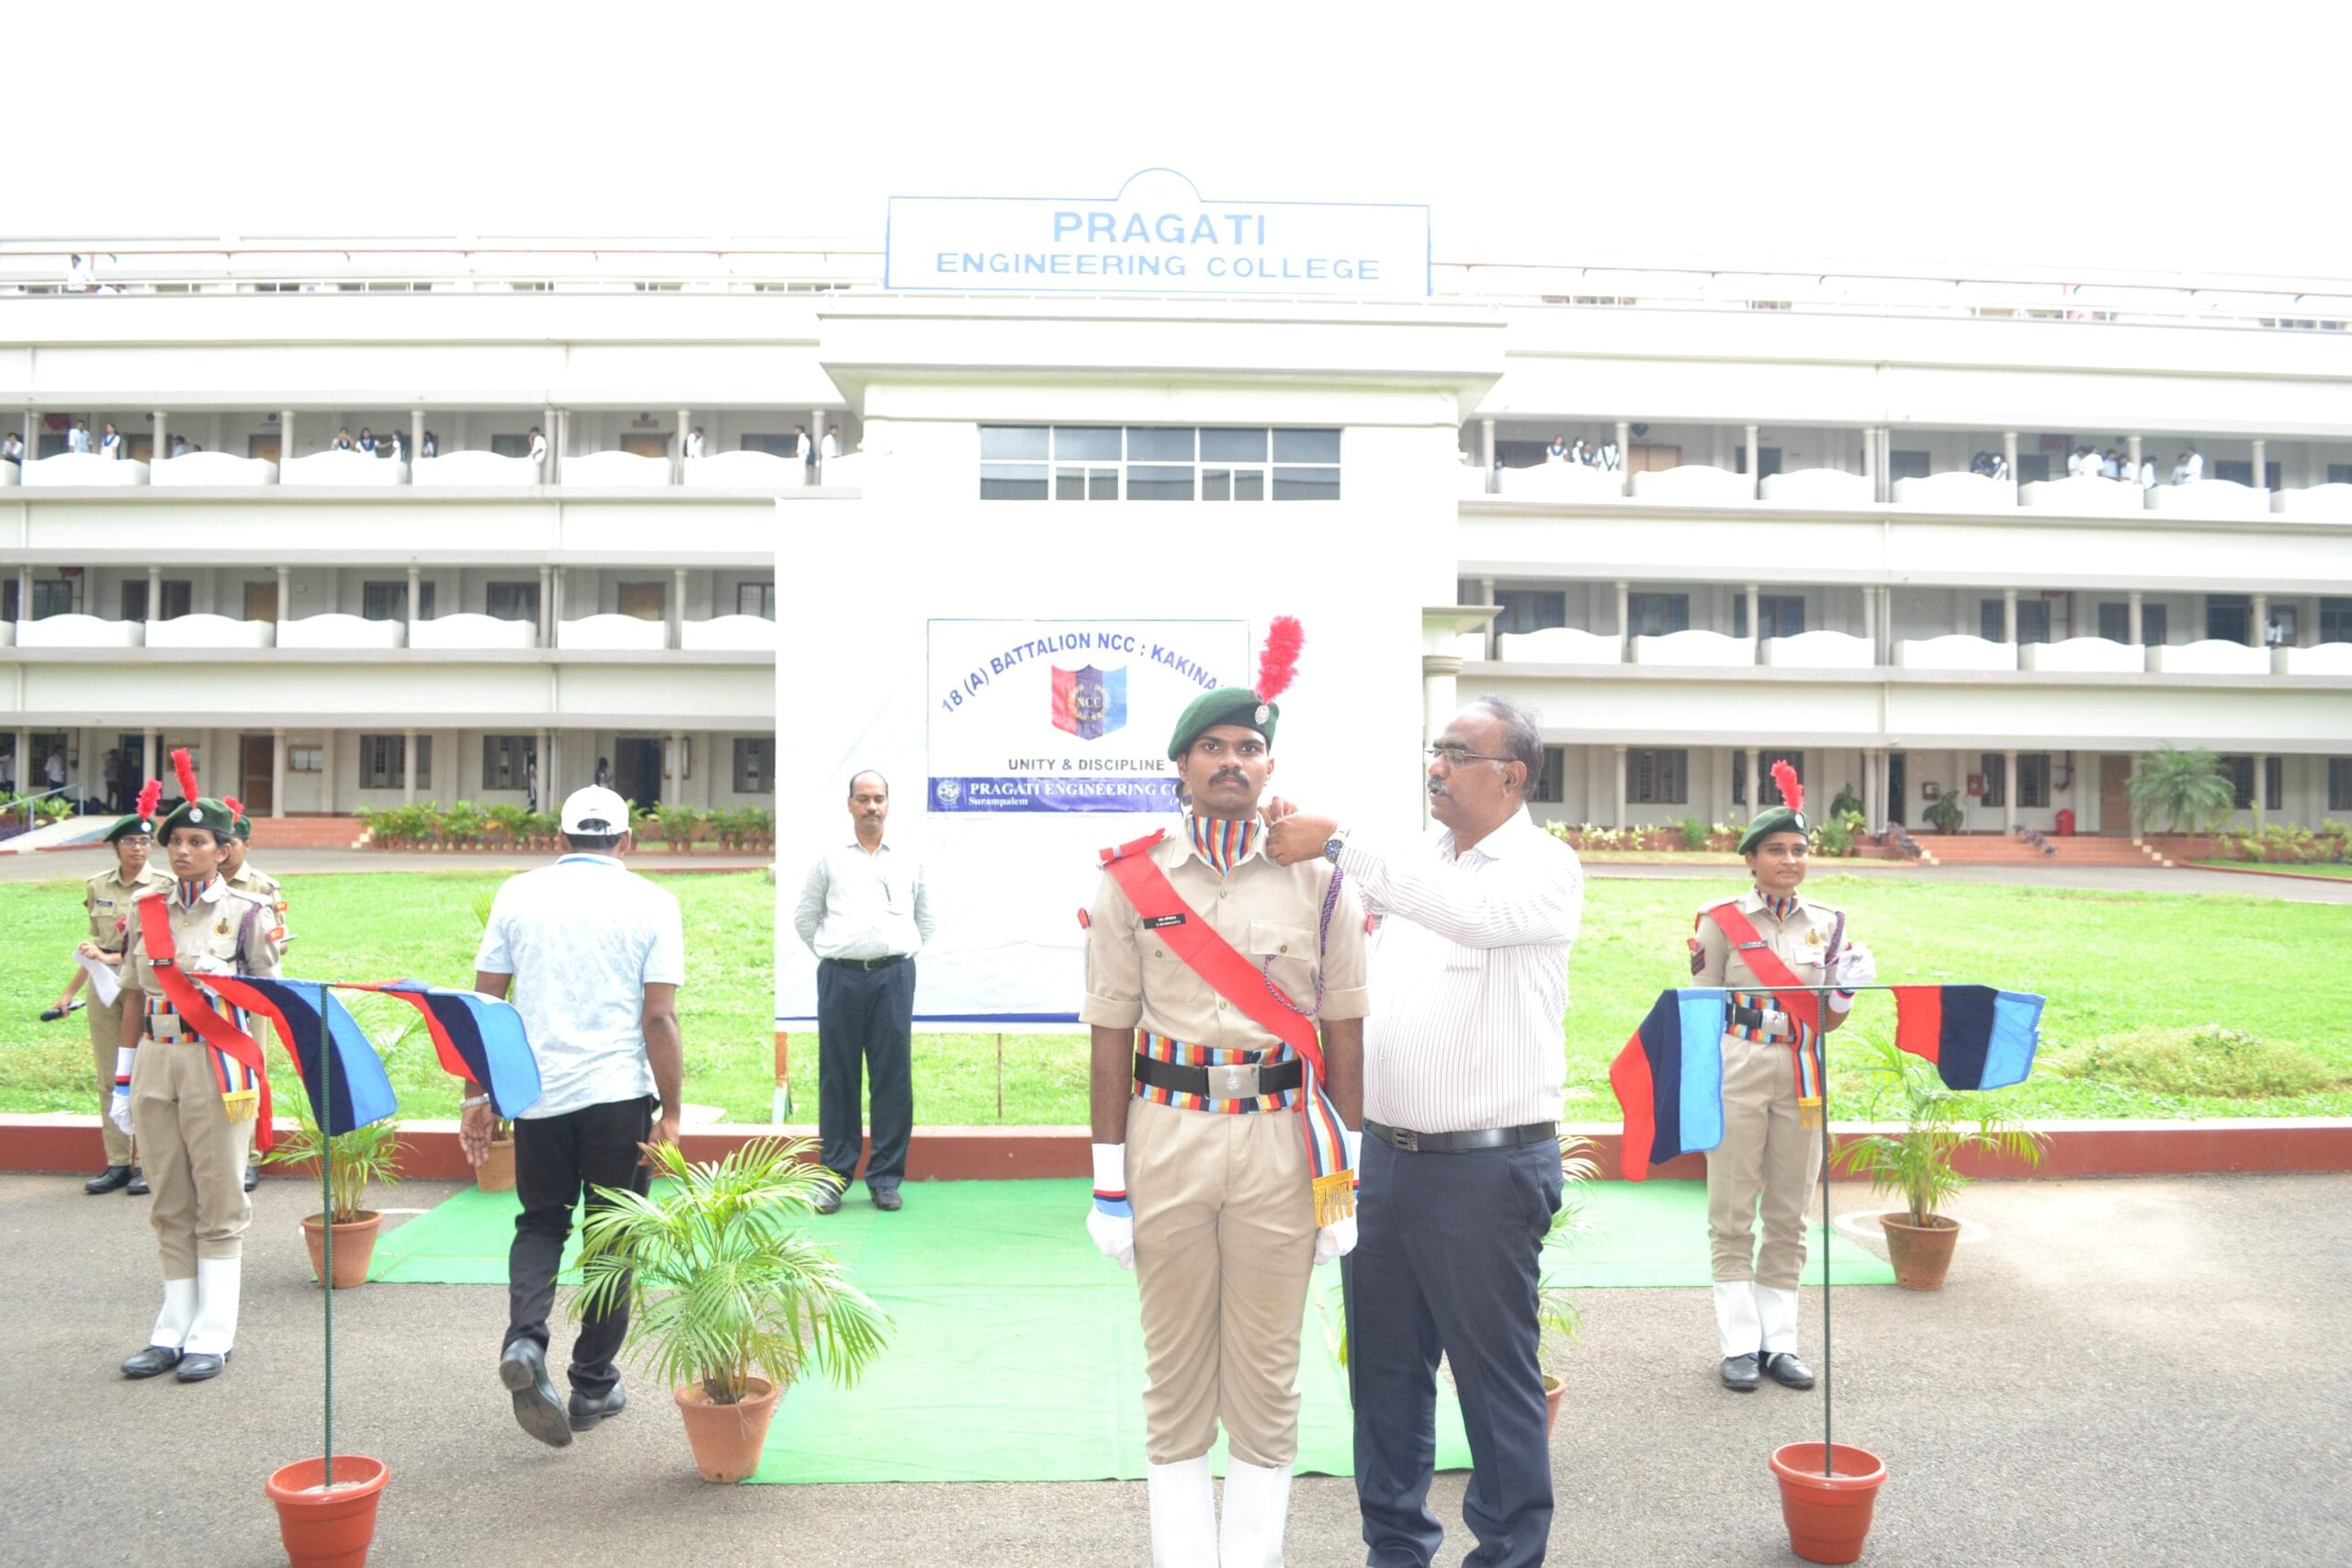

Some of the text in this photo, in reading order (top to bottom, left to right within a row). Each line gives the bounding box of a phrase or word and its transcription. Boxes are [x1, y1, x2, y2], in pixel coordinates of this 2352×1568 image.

[1053, 211, 1266, 246] PRAGATI
[936, 253, 1380, 280] ENGINEERING COLLEGE
[942, 689, 963, 713] 18
[964, 667, 989, 697] (A)
[989, 632, 1091, 675] BATTALION
[1098, 632, 1135, 653] NCC
[1150, 643, 1225, 690] KAKINA
[1078, 696, 1102, 707] NCC
[1008, 758, 1165, 772] UNITY & DISCIPLINE
[969, 783, 1040, 795] PRAGATI
[1044, 783, 1157, 796] ENGINEERING
[967, 796, 1029, 807] Surampalem
